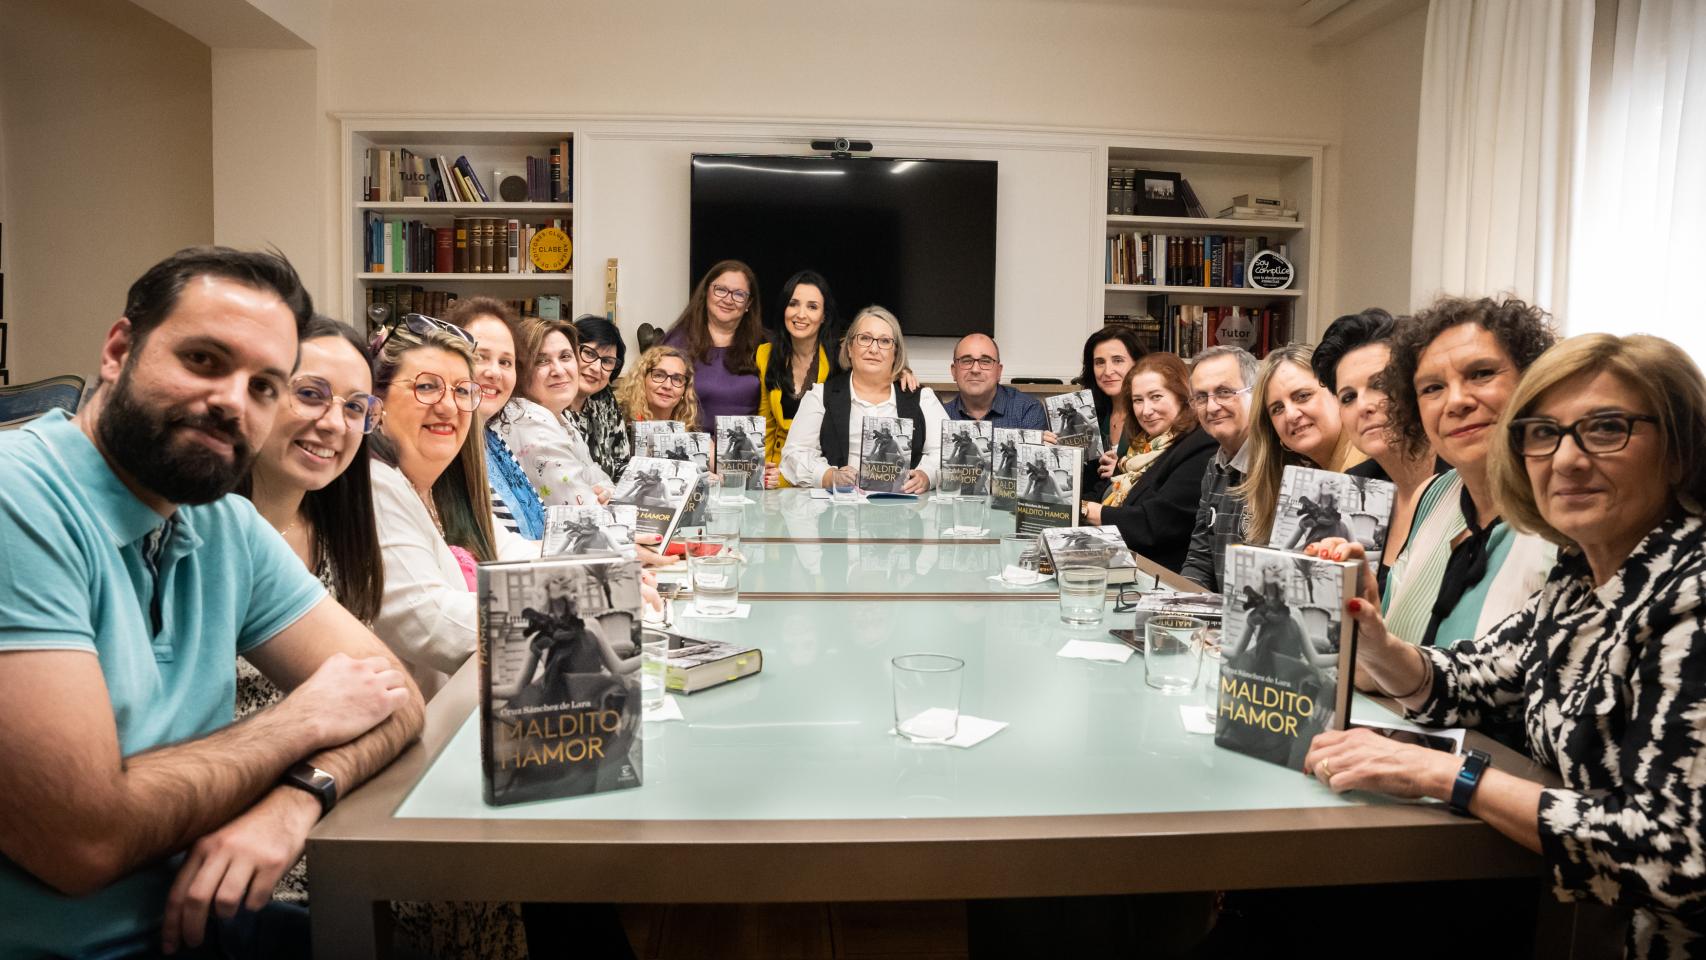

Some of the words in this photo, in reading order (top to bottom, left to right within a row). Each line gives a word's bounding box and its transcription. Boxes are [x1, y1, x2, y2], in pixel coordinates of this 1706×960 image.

[399, 171, 430, 181] Tutor
[1220, 328, 1251, 338] Tutor
[864, 464, 902, 474] MALDITO
[640, 511, 671, 521] HAMOR
[1017, 506, 1044, 516] MALDITO
[1044, 510, 1070, 520] HAMOR
[1221, 675, 1313, 717] MALDITO
[560, 701, 570, 711] de
[571, 699, 591, 709] Lara
[501, 709, 621, 742] MALDITO
[1220, 700, 1299, 738] HAMOR
[501, 737, 605, 769] HAMOR
